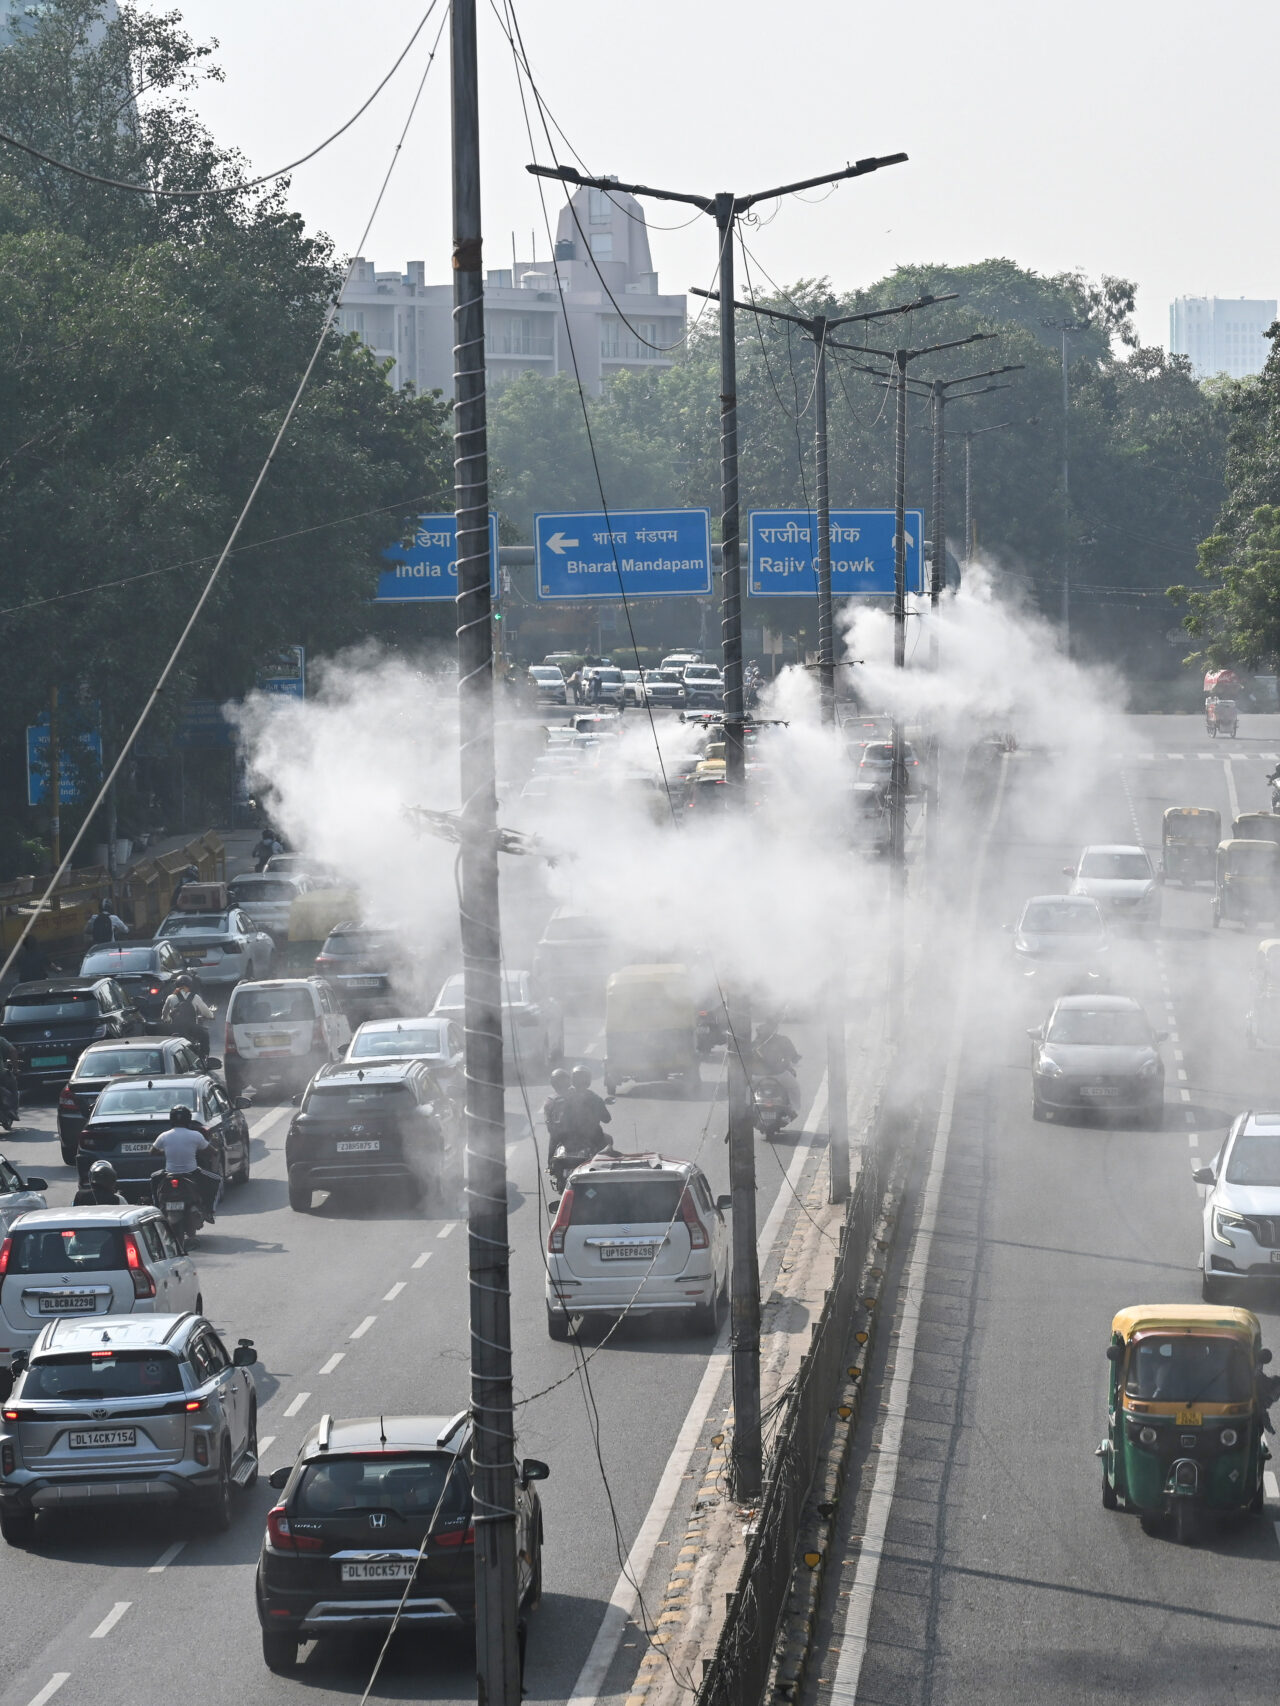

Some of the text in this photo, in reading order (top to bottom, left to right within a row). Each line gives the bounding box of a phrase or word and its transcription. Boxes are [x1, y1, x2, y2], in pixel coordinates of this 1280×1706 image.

[592, 528, 678, 545] भारत मंडपम
[758, 522, 811, 544] राजीव
[395, 562, 441, 578] India
[567, 558, 704, 574] Bharat Mandapam
[759, 557, 805, 576] Rajiv
[75, 1431, 134, 1445] DL14CK7154
[347, 1564, 415, 1578] DL10CK5718
